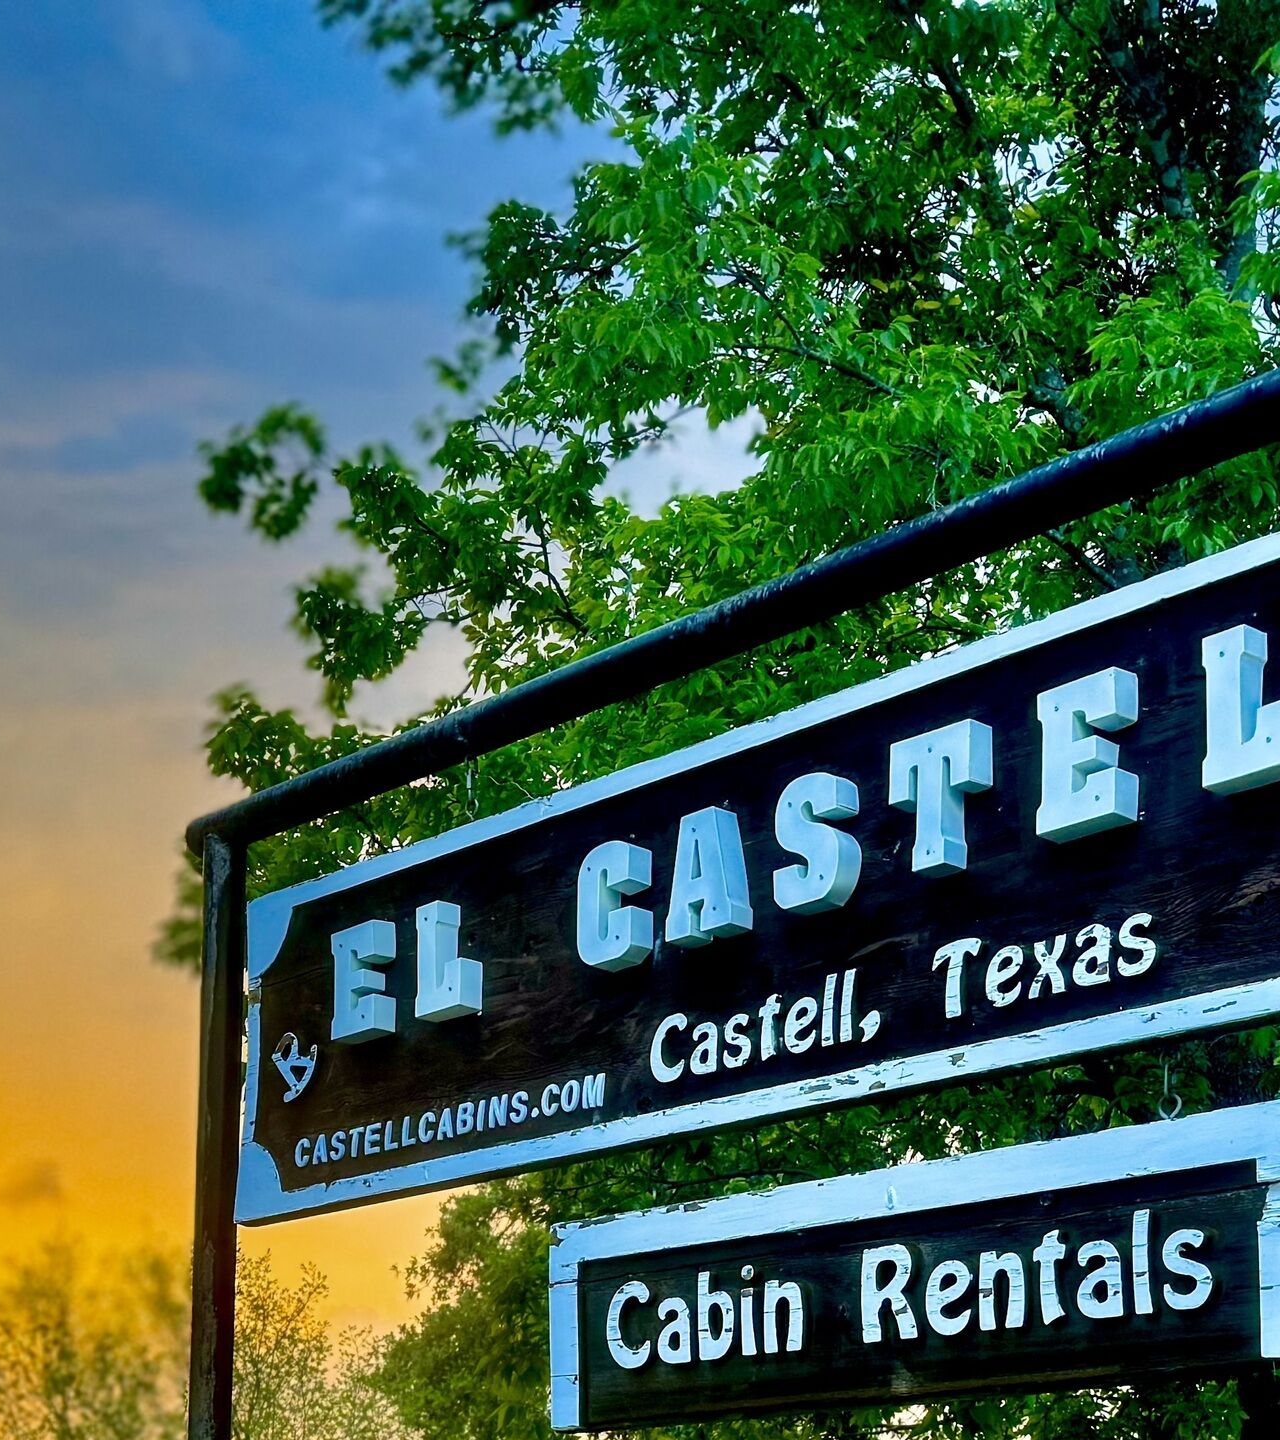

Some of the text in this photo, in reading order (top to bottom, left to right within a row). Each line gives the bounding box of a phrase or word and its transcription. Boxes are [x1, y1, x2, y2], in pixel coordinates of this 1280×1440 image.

[330, 900, 483, 1044] EL
[650, 912, 1158, 1083] Castell, Texas
[294, 1073, 606, 1168] CASTELLCABINS.COM
[606, 1208, 1213, 1369] Cabin Rentals
